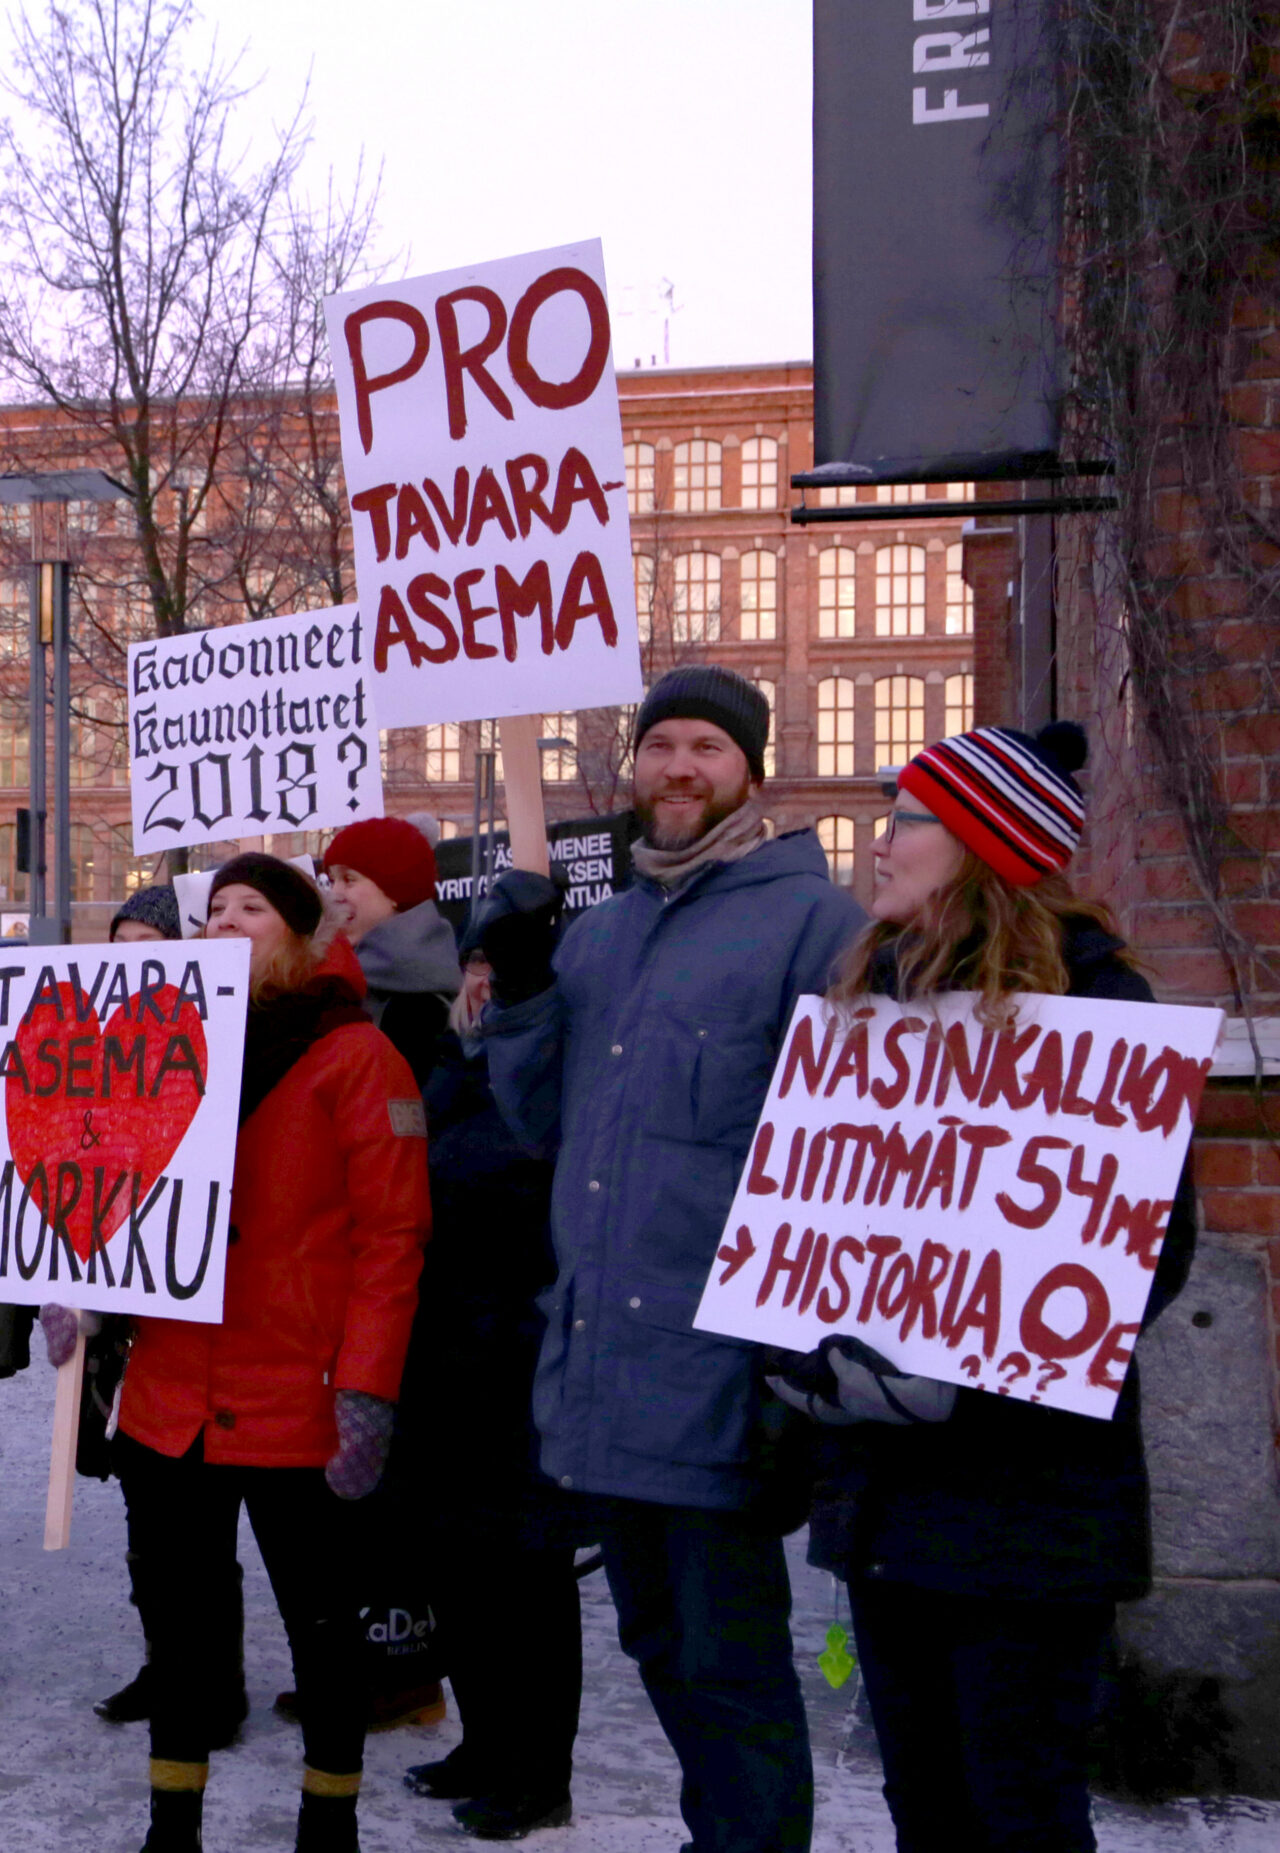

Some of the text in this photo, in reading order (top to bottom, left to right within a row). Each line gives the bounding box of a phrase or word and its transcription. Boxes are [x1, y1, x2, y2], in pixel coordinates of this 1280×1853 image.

[344, 267, 610, 455] PRO
[351, 447, 624, 562] TAVARA-
[133, 611, 364, 697] Kadonneet
[374, 551, 618, 673] ASEMA
[133, 677, 368, 760] Kaunottaret
[547, 832, 612, 861] MENEE
[80, 1109, 101, 1150] &
[756, 1222, 1002, 1361] HISTORIA
[359, 1604, 437, 1642] aDe
